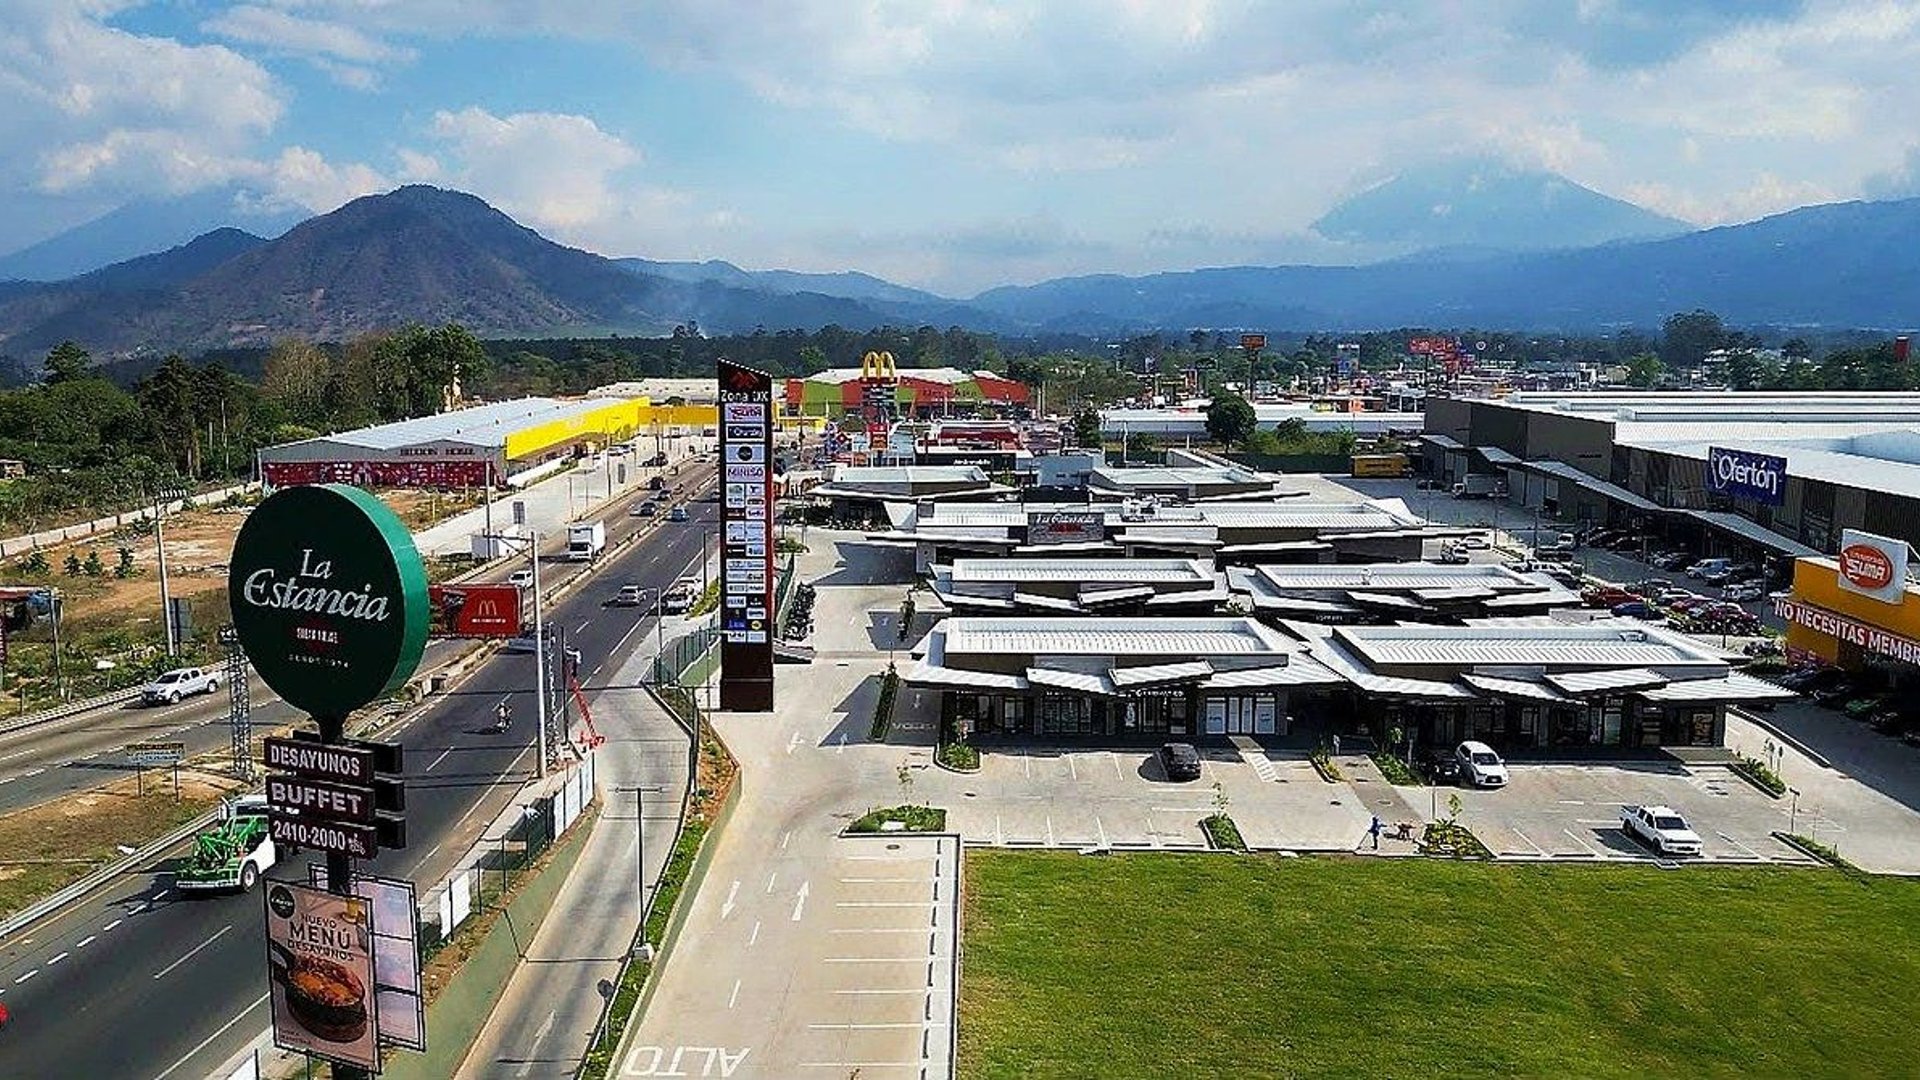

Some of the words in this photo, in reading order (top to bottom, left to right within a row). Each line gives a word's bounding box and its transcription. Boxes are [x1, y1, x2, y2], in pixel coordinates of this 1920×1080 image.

[728, 467, 763, 476] MINISO
[1719, 455, 1777, 495] Ofertón
[300, 549, 333, 579] La
[1846, 558, 1886, 580] SUMA
[244, 568, 390, 622] Estancia
[1775, 600, 1794, 620] NO
[1796, 607, 1865, 645] NECESITAS
[271, 745, 360, 776] DESAYUNOS
[271, 783, 362, 814] BUFFET
[290, 921, 350, 949] MENÚ
[301, 914, 337, 929] NUEVO
[287, 939, 355, 962] DESAYUNOS
[623, 1046, 751, 1077] ALTO
